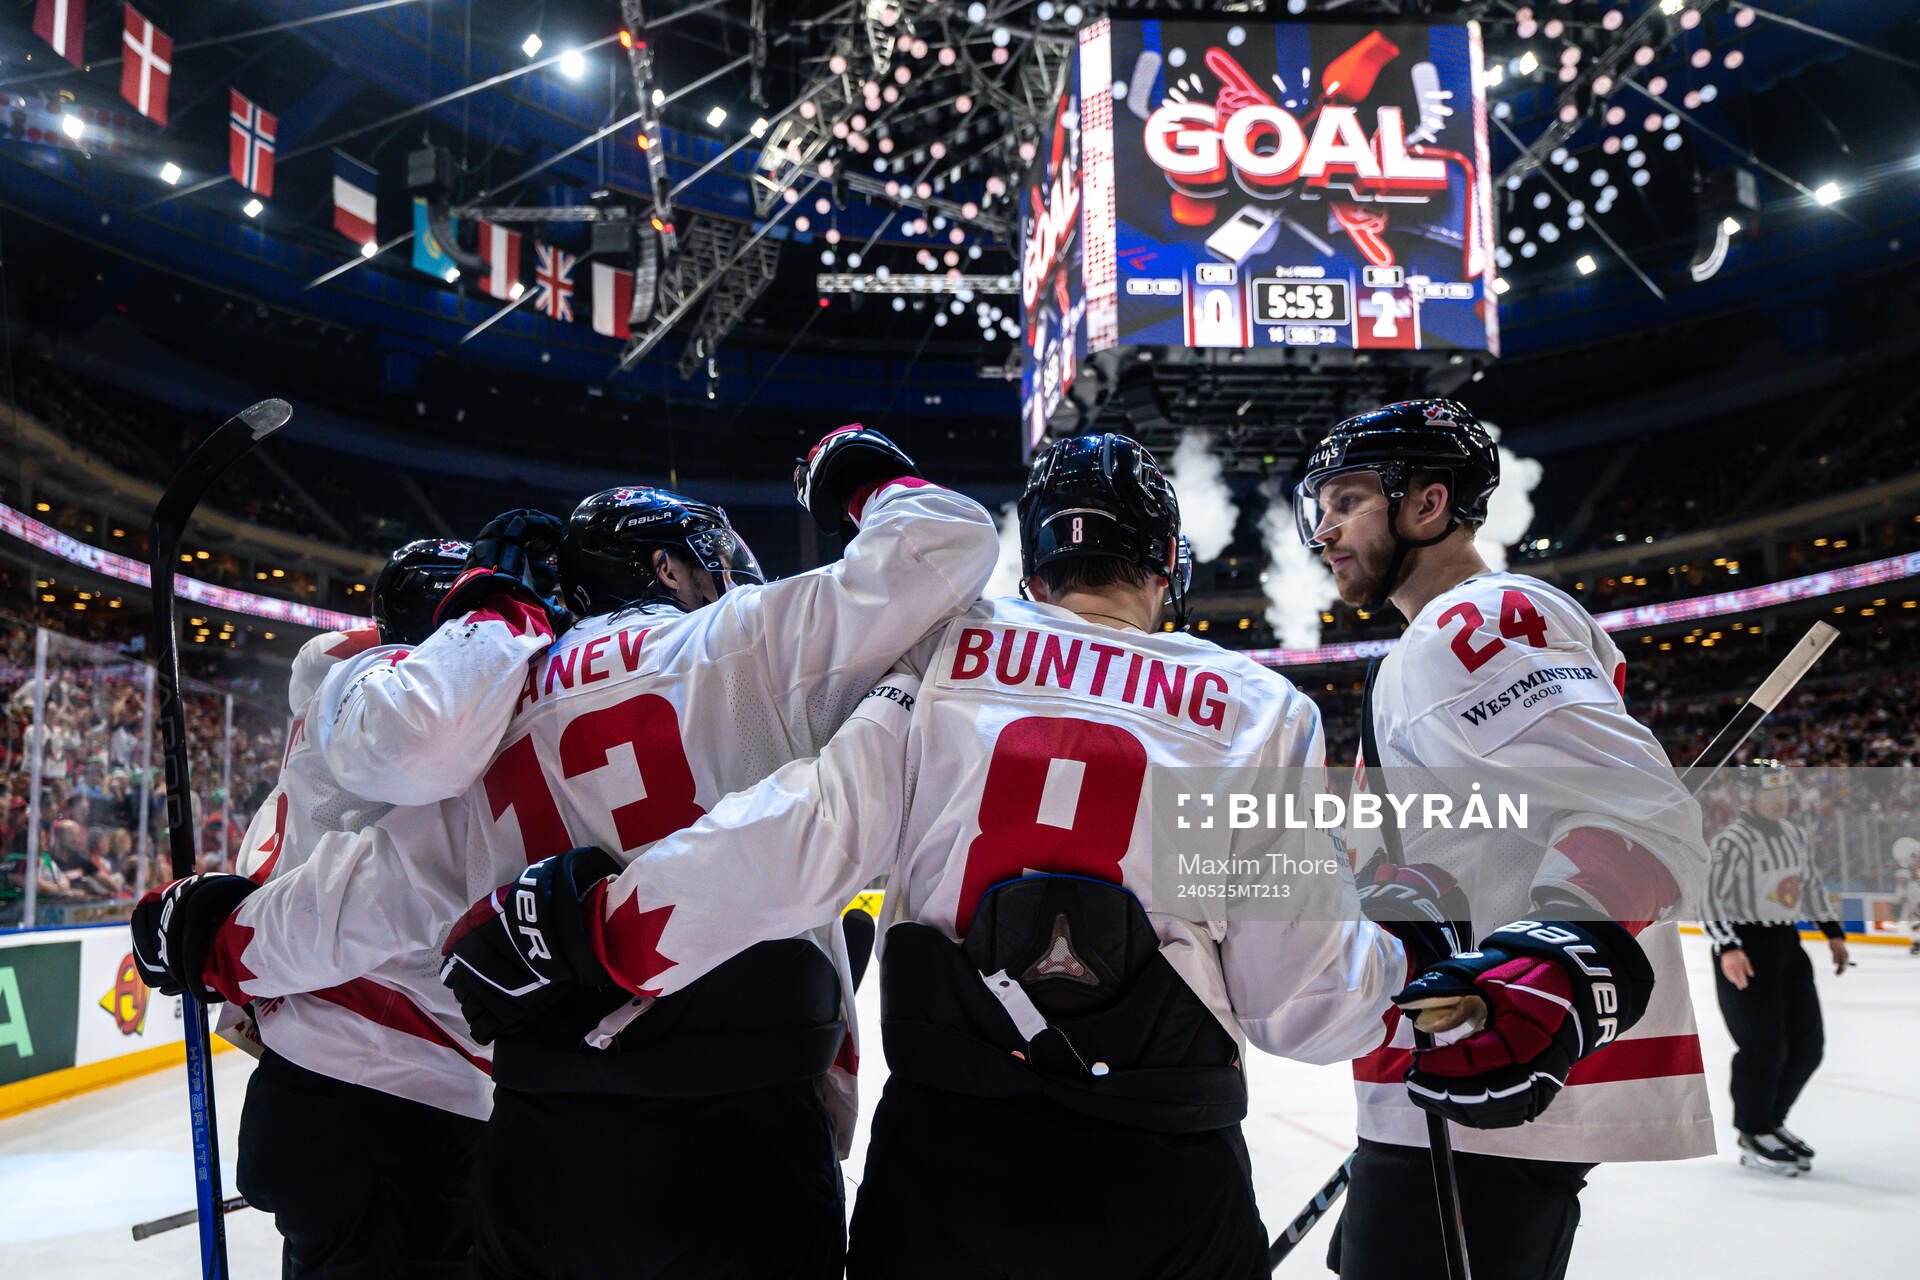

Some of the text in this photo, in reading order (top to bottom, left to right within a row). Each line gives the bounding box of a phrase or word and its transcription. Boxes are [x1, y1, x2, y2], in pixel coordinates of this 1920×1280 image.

[1143, 101, 1447, 193] GOAL
[1268, 284, 1334, 319] 5:53
[1371, 291, 1398, 338] 2
[627, 511, 672, 527] BAUER
[1072, 517, 1083, 544] 8
[1436, 590, 1550, 674] 24
[950, 628, 1230, 732] BUNTING
[1460, 667, 1599, 727] WESTMINSTER
[1522, 684, 1563, 710] GROUP
[483, 693, 707, 866] 13
[954, 716, 1147, 934] 8
